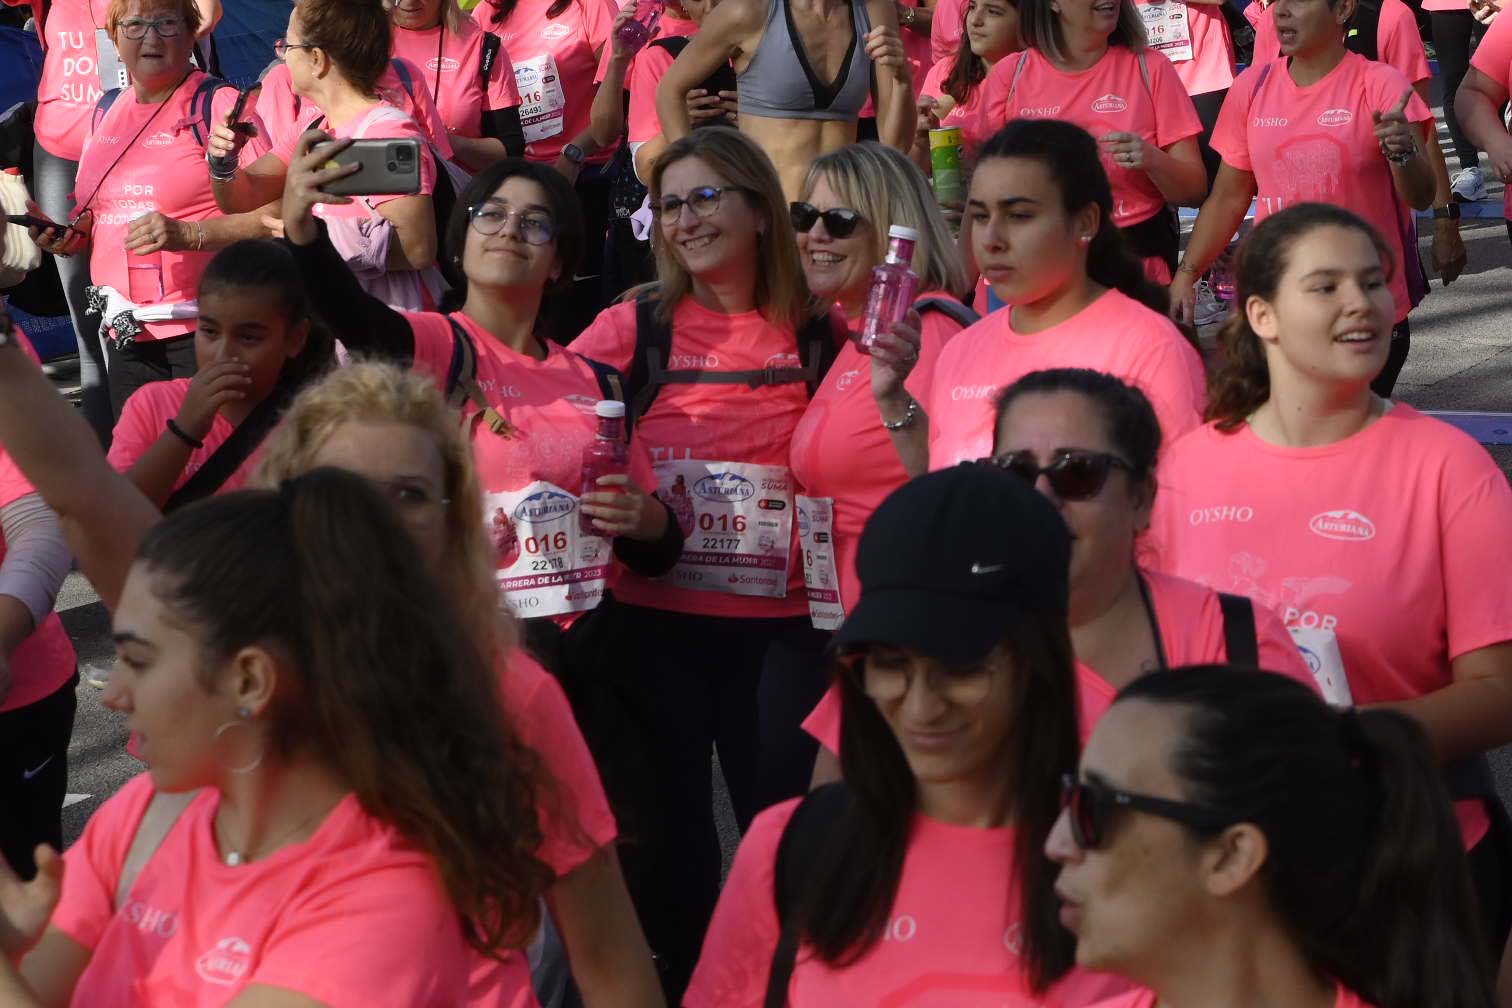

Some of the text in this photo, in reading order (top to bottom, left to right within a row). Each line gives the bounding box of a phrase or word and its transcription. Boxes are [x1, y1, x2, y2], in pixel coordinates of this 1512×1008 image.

[57, 32, 85, 50] TU
[63, 57, 99, 76] DO
[123, 184, 155, 197] POR
[668, 354, 720, 369] YSHO
[699, 512, 747, 533] 016
[1189, 506, 1254, 526] OYSHO
[524, 531, 568, 554] 016
[702, 538, 741, 550] 22177
[705, 555, 718, 564] DE
[718, 555, 731, 564] LA
[500, 576, 536, 590] ARRERA
[537, 576, 550, 584] DE
[551, 575, 564, 584] LA
[1283, 607, 1338, 633] POR
